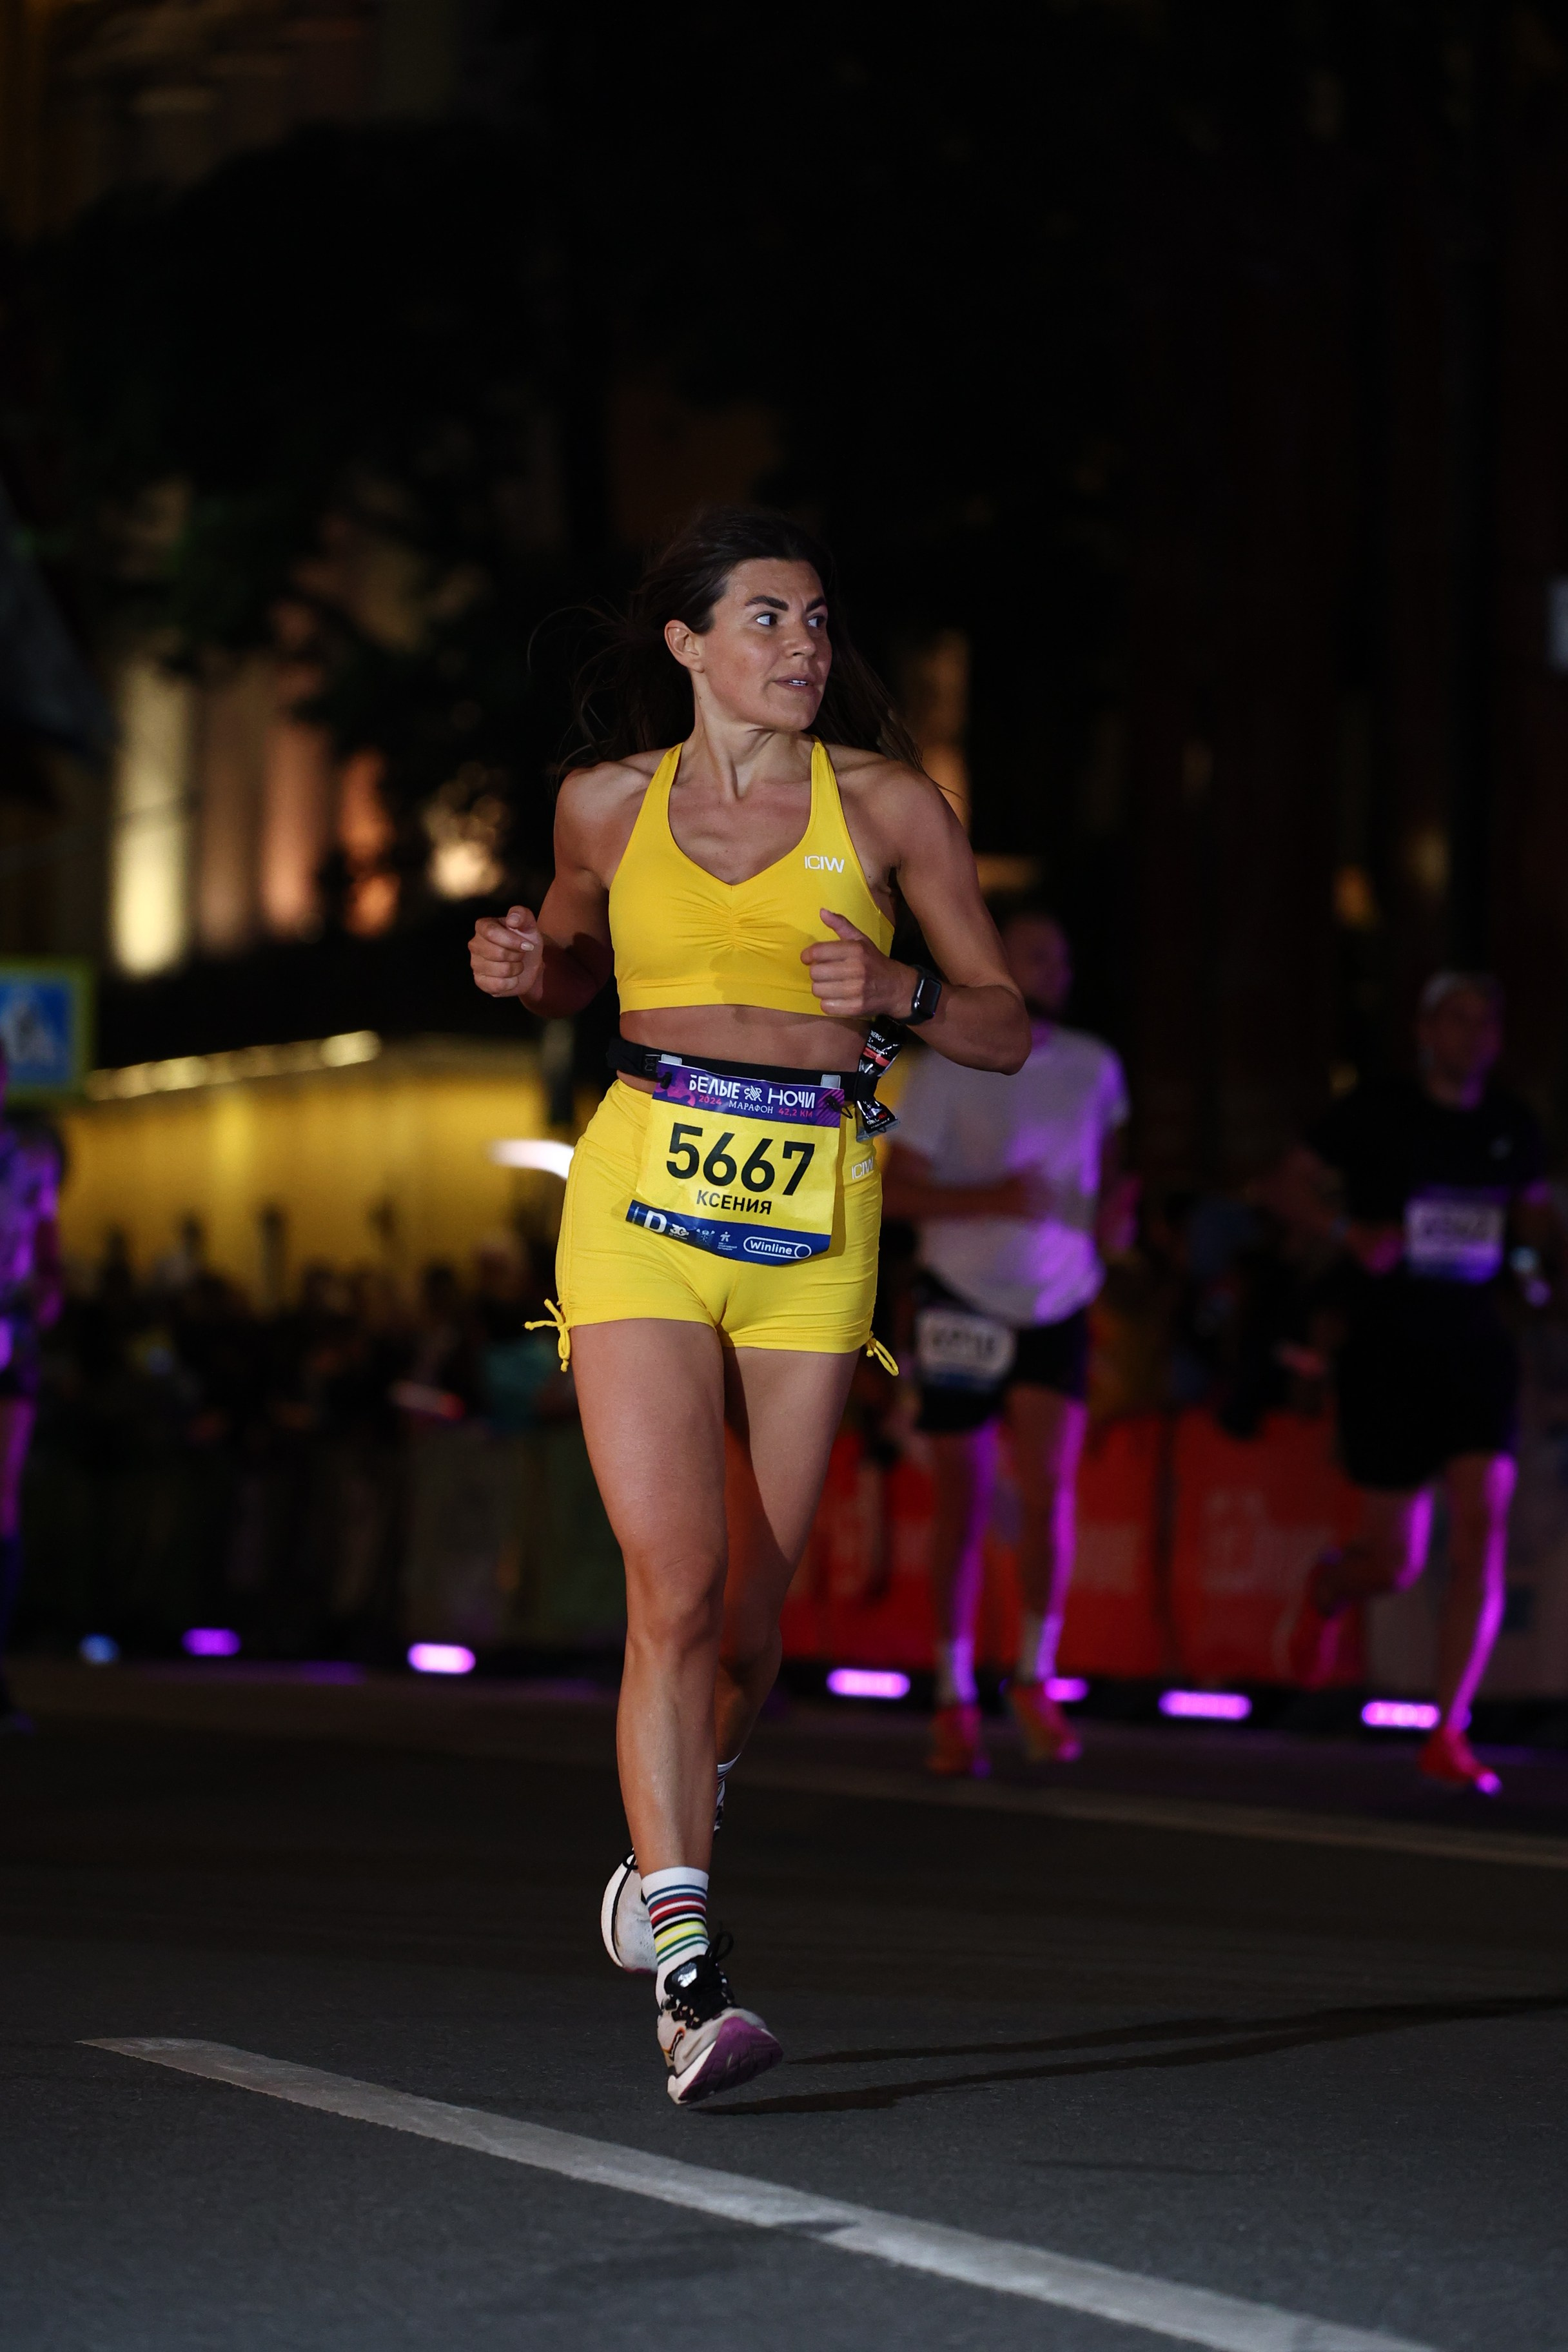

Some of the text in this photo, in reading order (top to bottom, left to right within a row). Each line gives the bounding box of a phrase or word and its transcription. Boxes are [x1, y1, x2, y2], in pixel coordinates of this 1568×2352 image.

[805, 855, 845, 873] ICIW
[689, 1074, 816, 1109] БЕЛЫЕ НОЧИ
[699, 1095, 722, 1105] 2024
[729, 1100, 774, 1114] МАРАФОН
[667, 1122, 815, 1195] 5667
[696, 1190, 772, 1215] КСЕНИЯ
[750, 1240, 792, 1255] Winline
